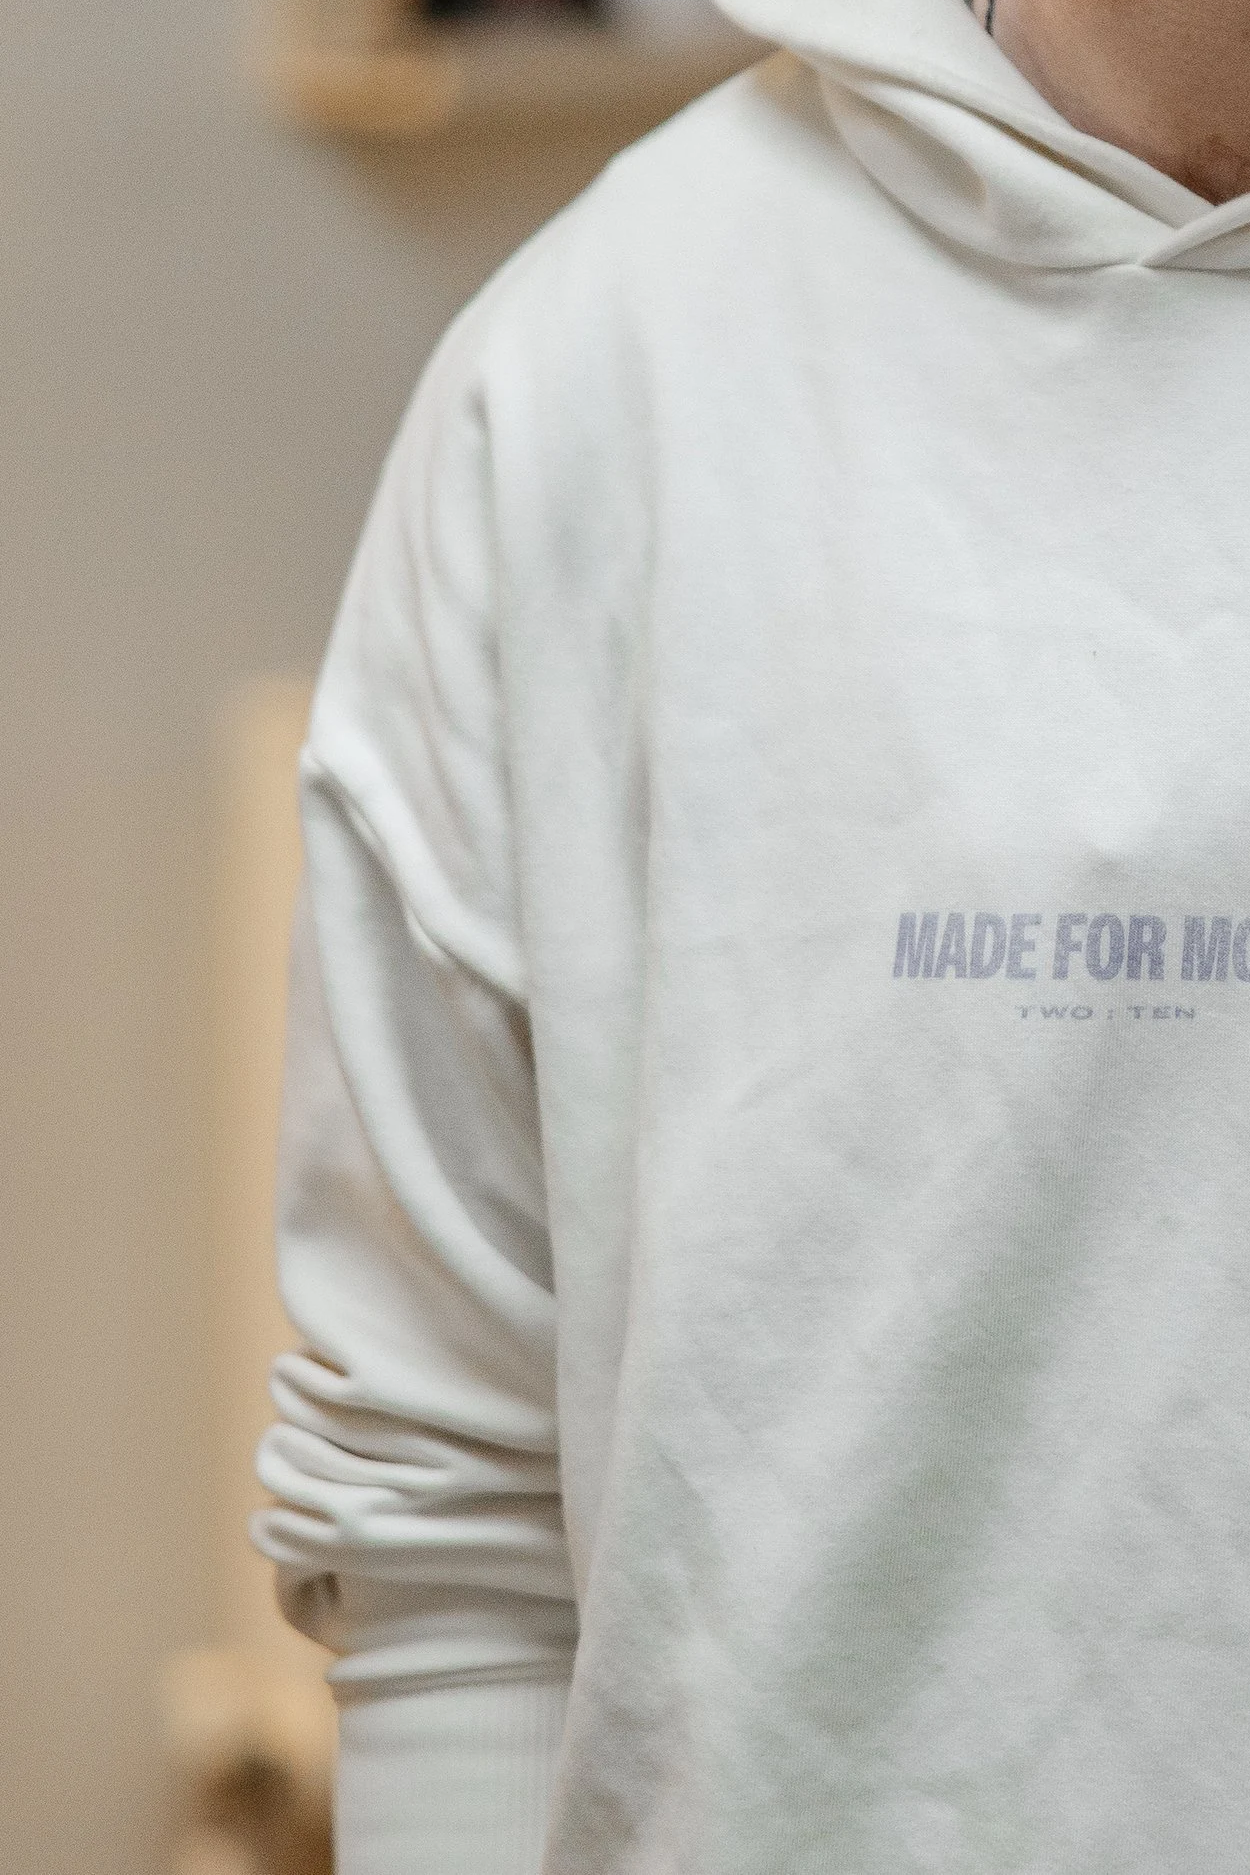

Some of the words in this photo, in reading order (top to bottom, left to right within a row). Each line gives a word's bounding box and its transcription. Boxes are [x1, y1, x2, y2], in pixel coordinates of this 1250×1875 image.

[892, 911, 1042, 980] MADE
[1051, 912, 1168, 982] FOR
[1014, 1005, 1094, 1021] TWO
[1126, 1004, 1196, 1021] TEN
